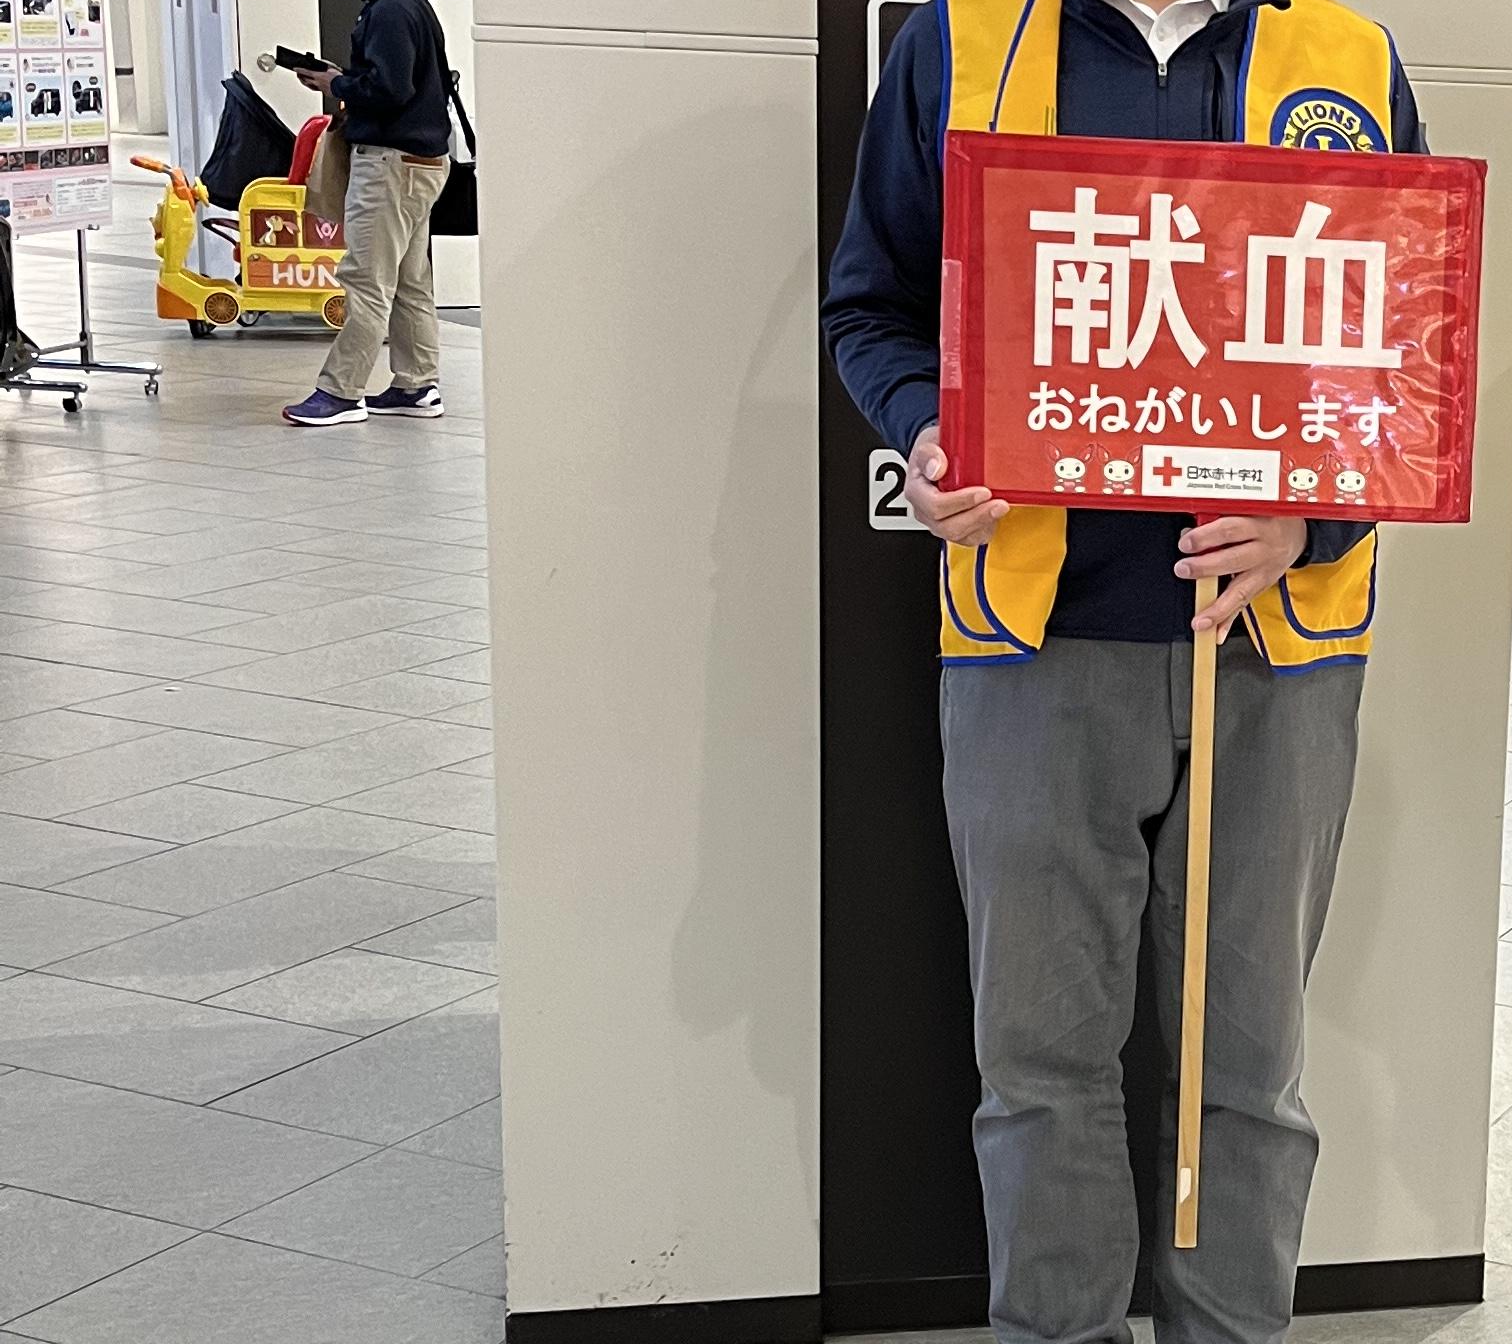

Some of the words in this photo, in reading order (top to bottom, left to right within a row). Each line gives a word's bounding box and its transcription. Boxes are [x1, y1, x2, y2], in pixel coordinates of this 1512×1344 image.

[1294, 103, 1357, 131] LIONS
[1029, 186, 1403, 370] 献血
[1027, 381, 1397, 447] おねがいします
[1186, 465, 1263, 482] 日本赤十字社
